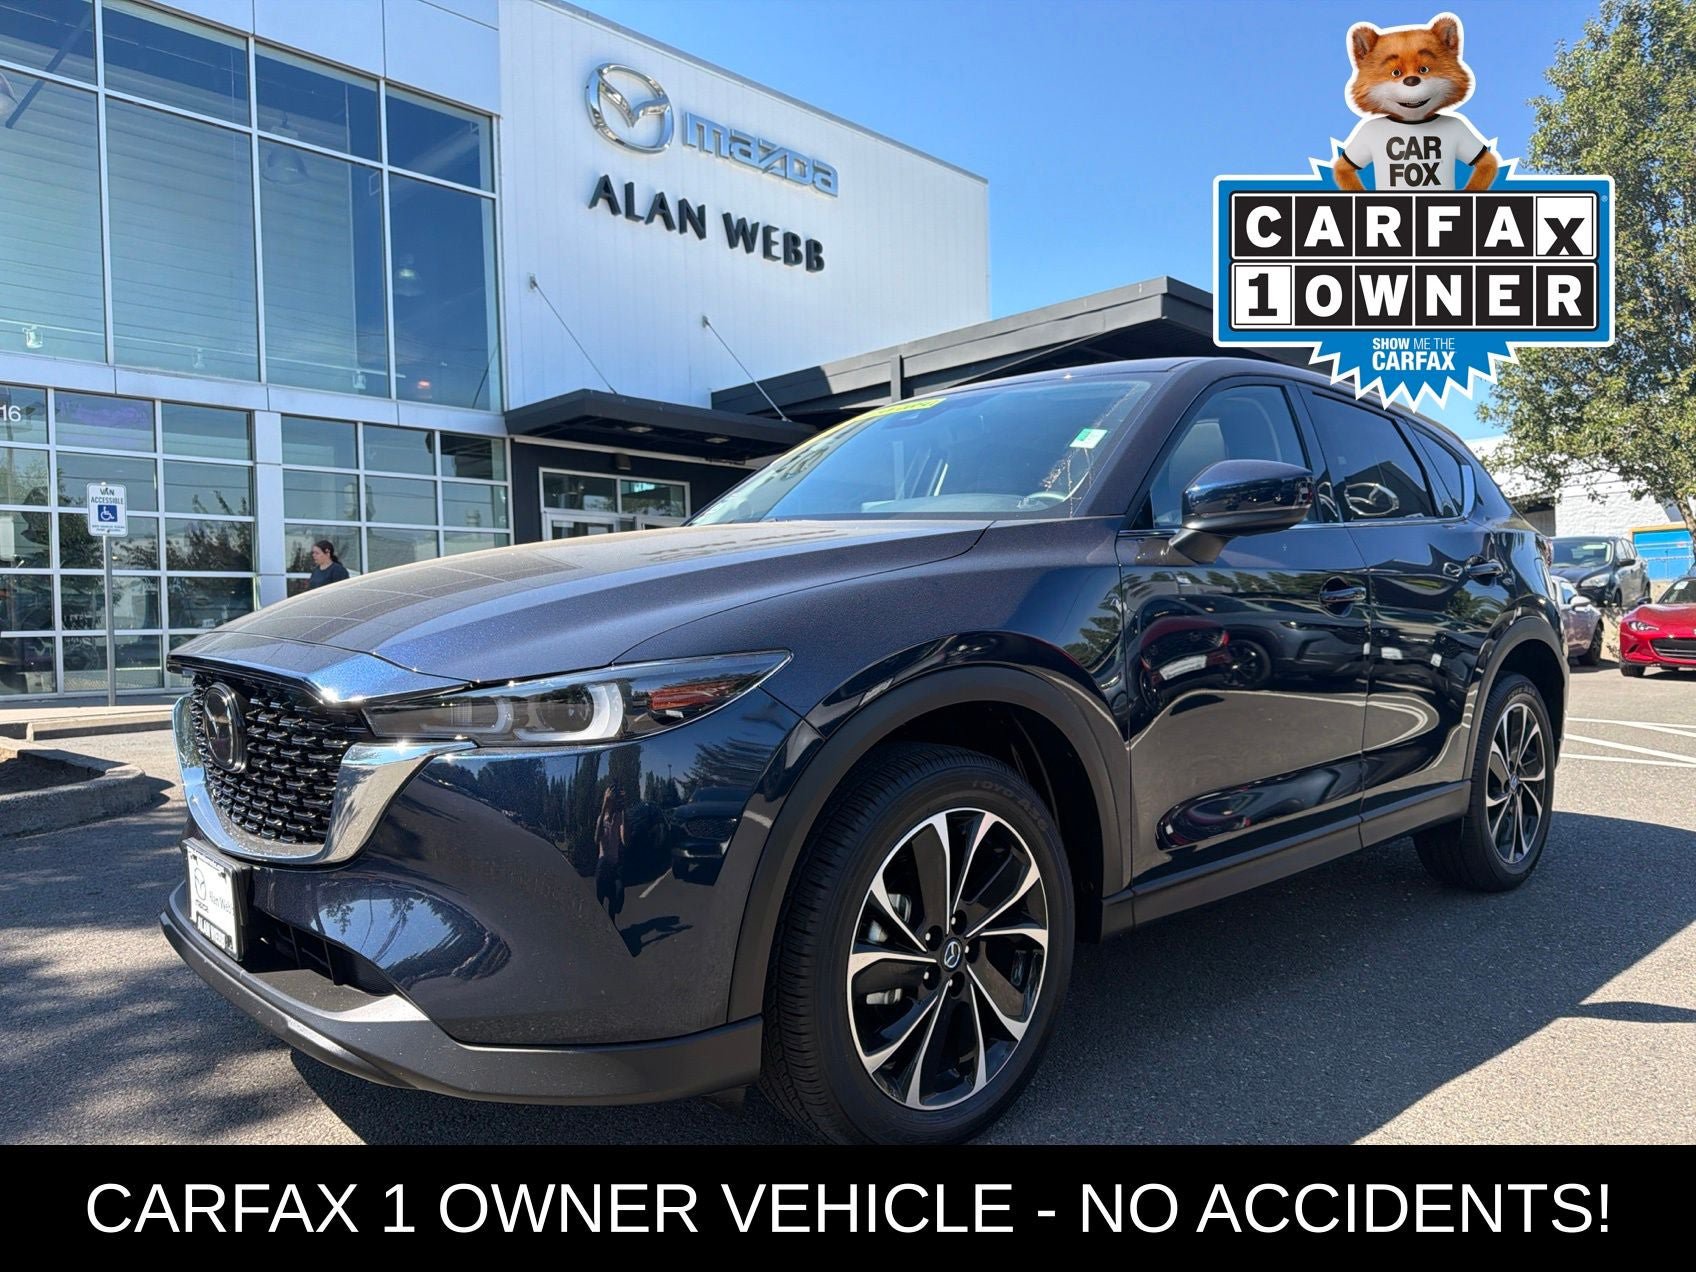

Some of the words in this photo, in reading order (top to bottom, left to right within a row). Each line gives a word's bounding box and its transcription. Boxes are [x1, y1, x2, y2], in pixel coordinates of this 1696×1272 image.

[588, 174, 707, 241] ALAN
[722, 212, 826, 273] WEBB
[99, 487, 115, 496] VAN
[90, 496, 124, 505] ACCESSIBLE
